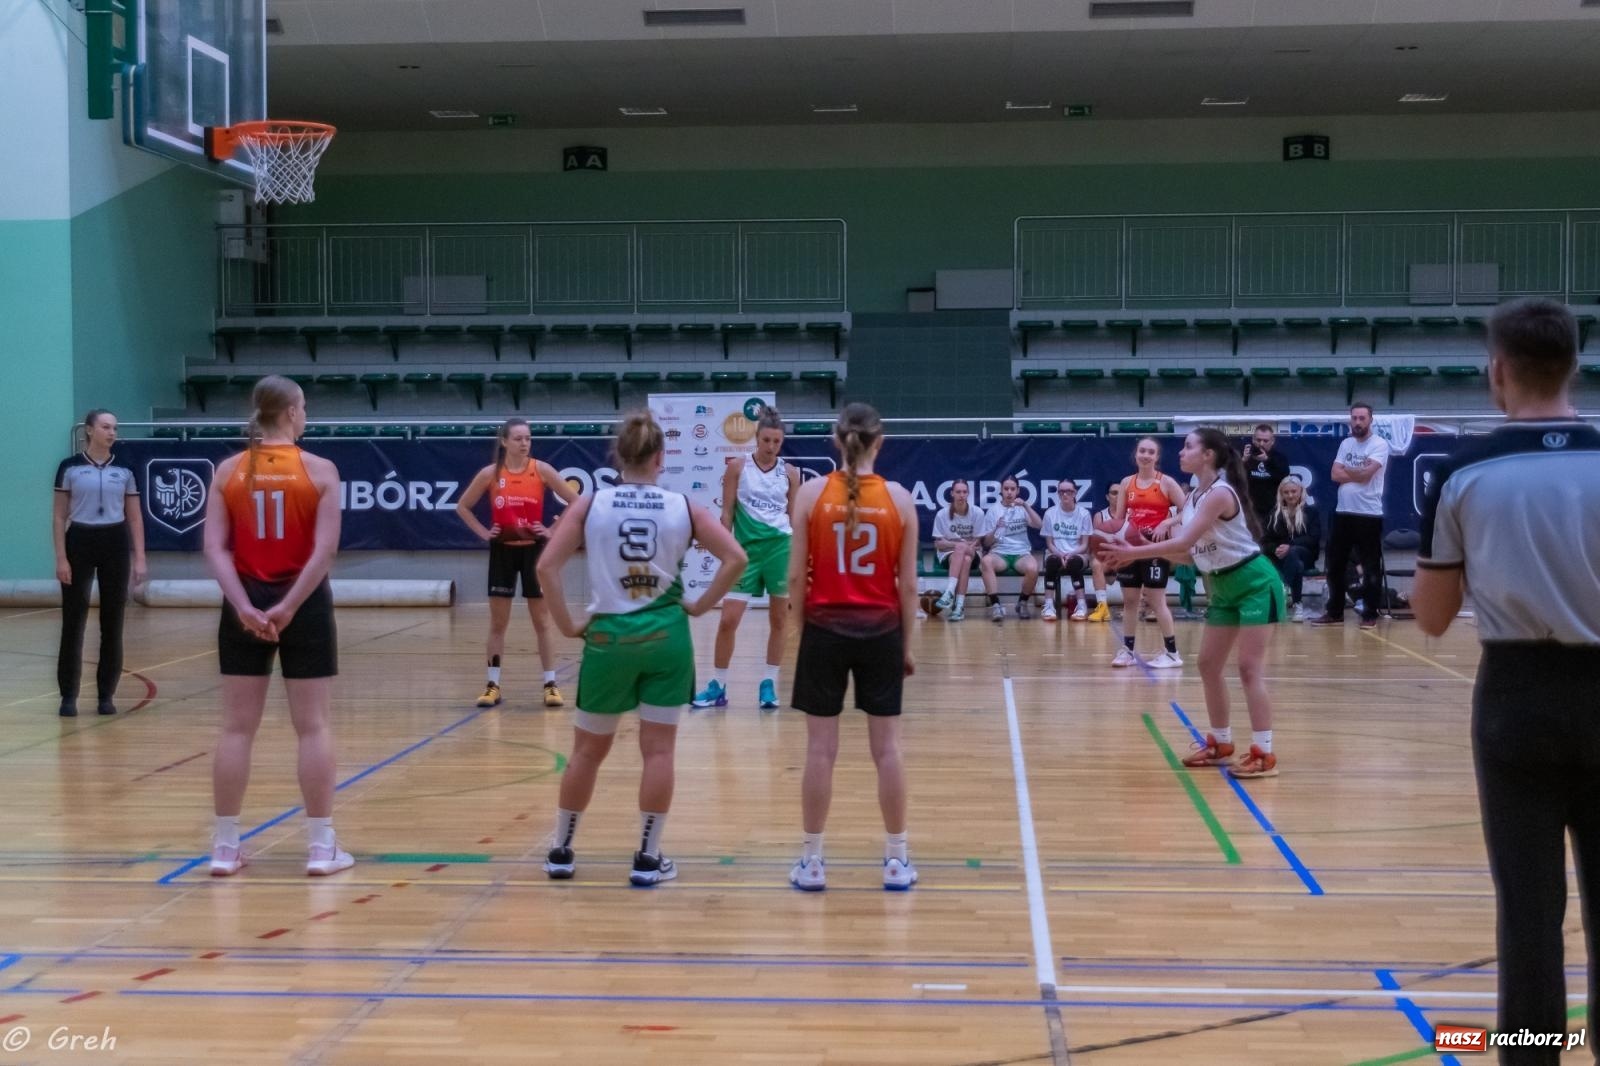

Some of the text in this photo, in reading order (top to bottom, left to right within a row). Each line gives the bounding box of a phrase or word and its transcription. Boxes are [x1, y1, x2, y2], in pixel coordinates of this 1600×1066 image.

[566, 155, 578, 168] A
[586, 155, 603, 168] A
[1289, 144, 1304, 157] B
[340, 470, 459, 510] IBÓRZ
[911, 469, 1093, 511] ACIBÓRZ
[252, 490, 285, 539] 11
[619, 518, 658, 562] 3
[832, 522, 878, 575] 12
[1149, 566, 1161, 580] 13
